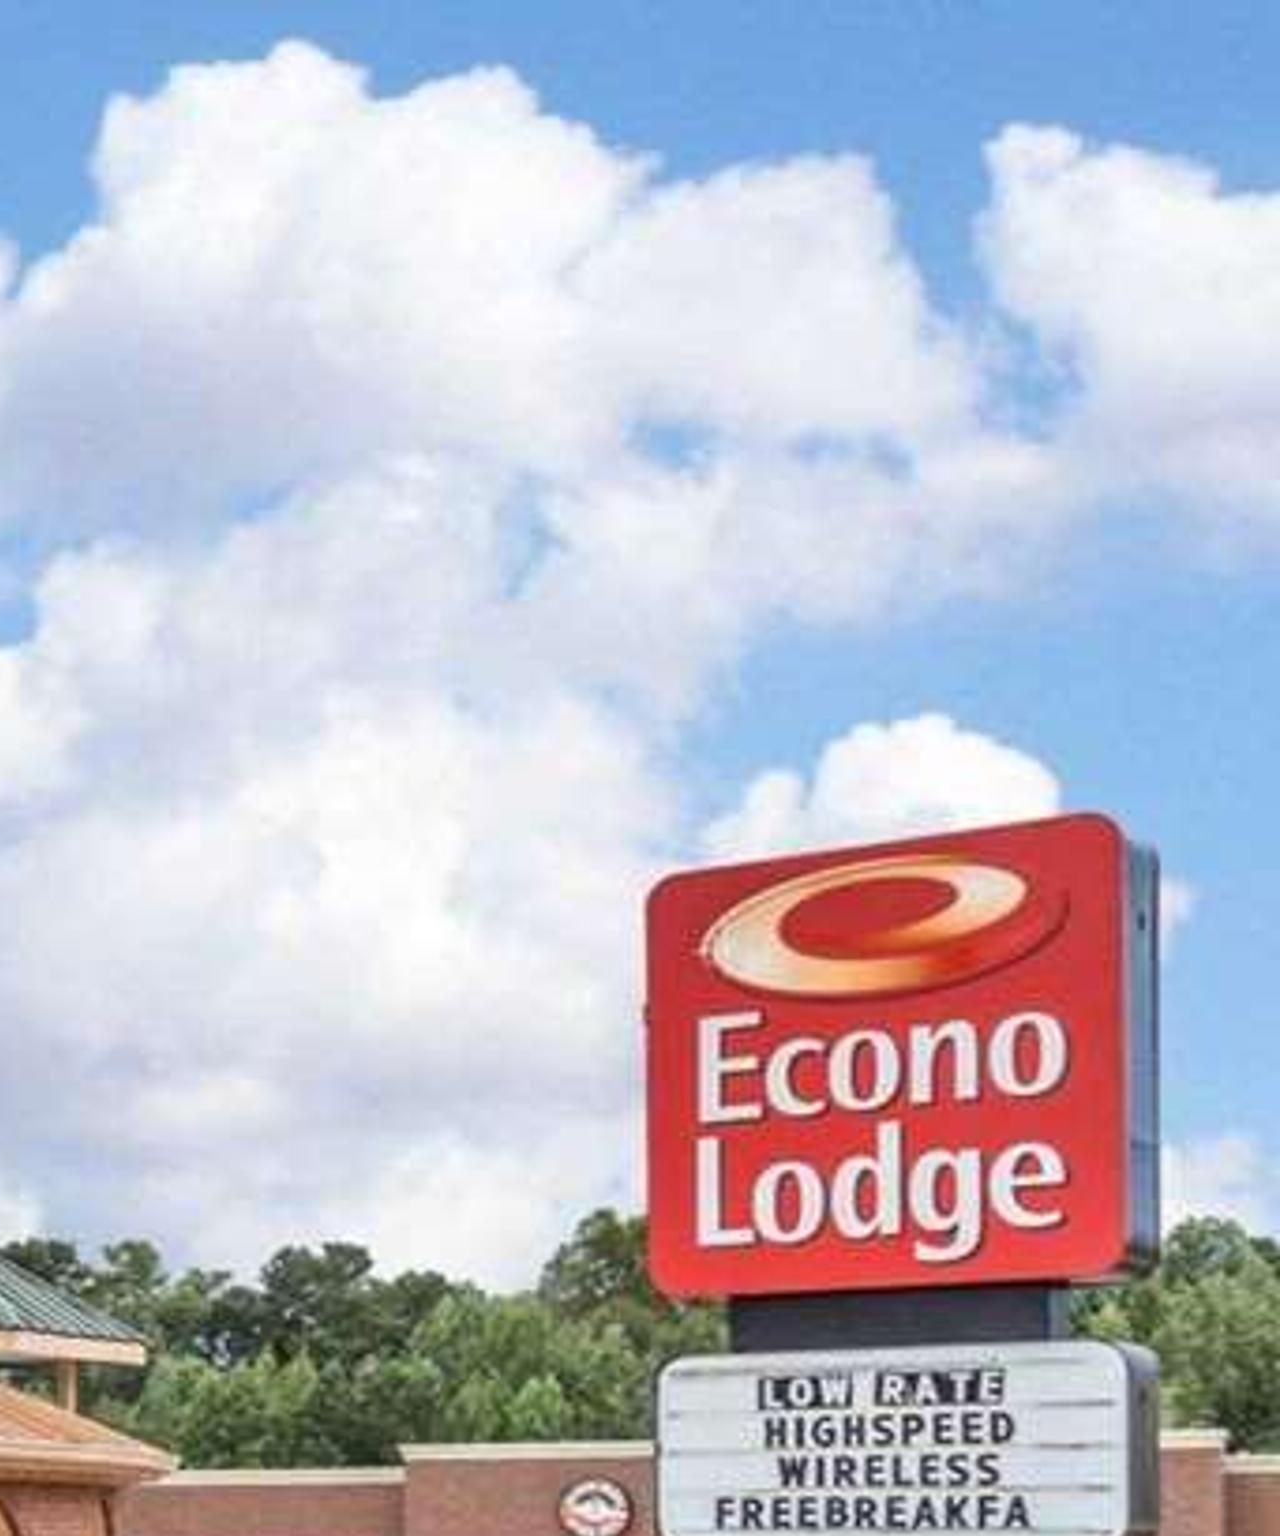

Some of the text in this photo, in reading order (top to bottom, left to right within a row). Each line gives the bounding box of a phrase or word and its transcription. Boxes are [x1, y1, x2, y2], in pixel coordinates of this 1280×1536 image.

[696, 1009, 1068, 1125] Econo
[695, 1122, 1067, 1262] Lodge
[760, 1370, 1004, 1410] LOW RATE
[764, 1413, 1015, 1447] HIGHSPEED
[779, 1454, 1001, 1487] WIRELESS
[715, 1495, 1030, 1530] FREEBREAKFA
